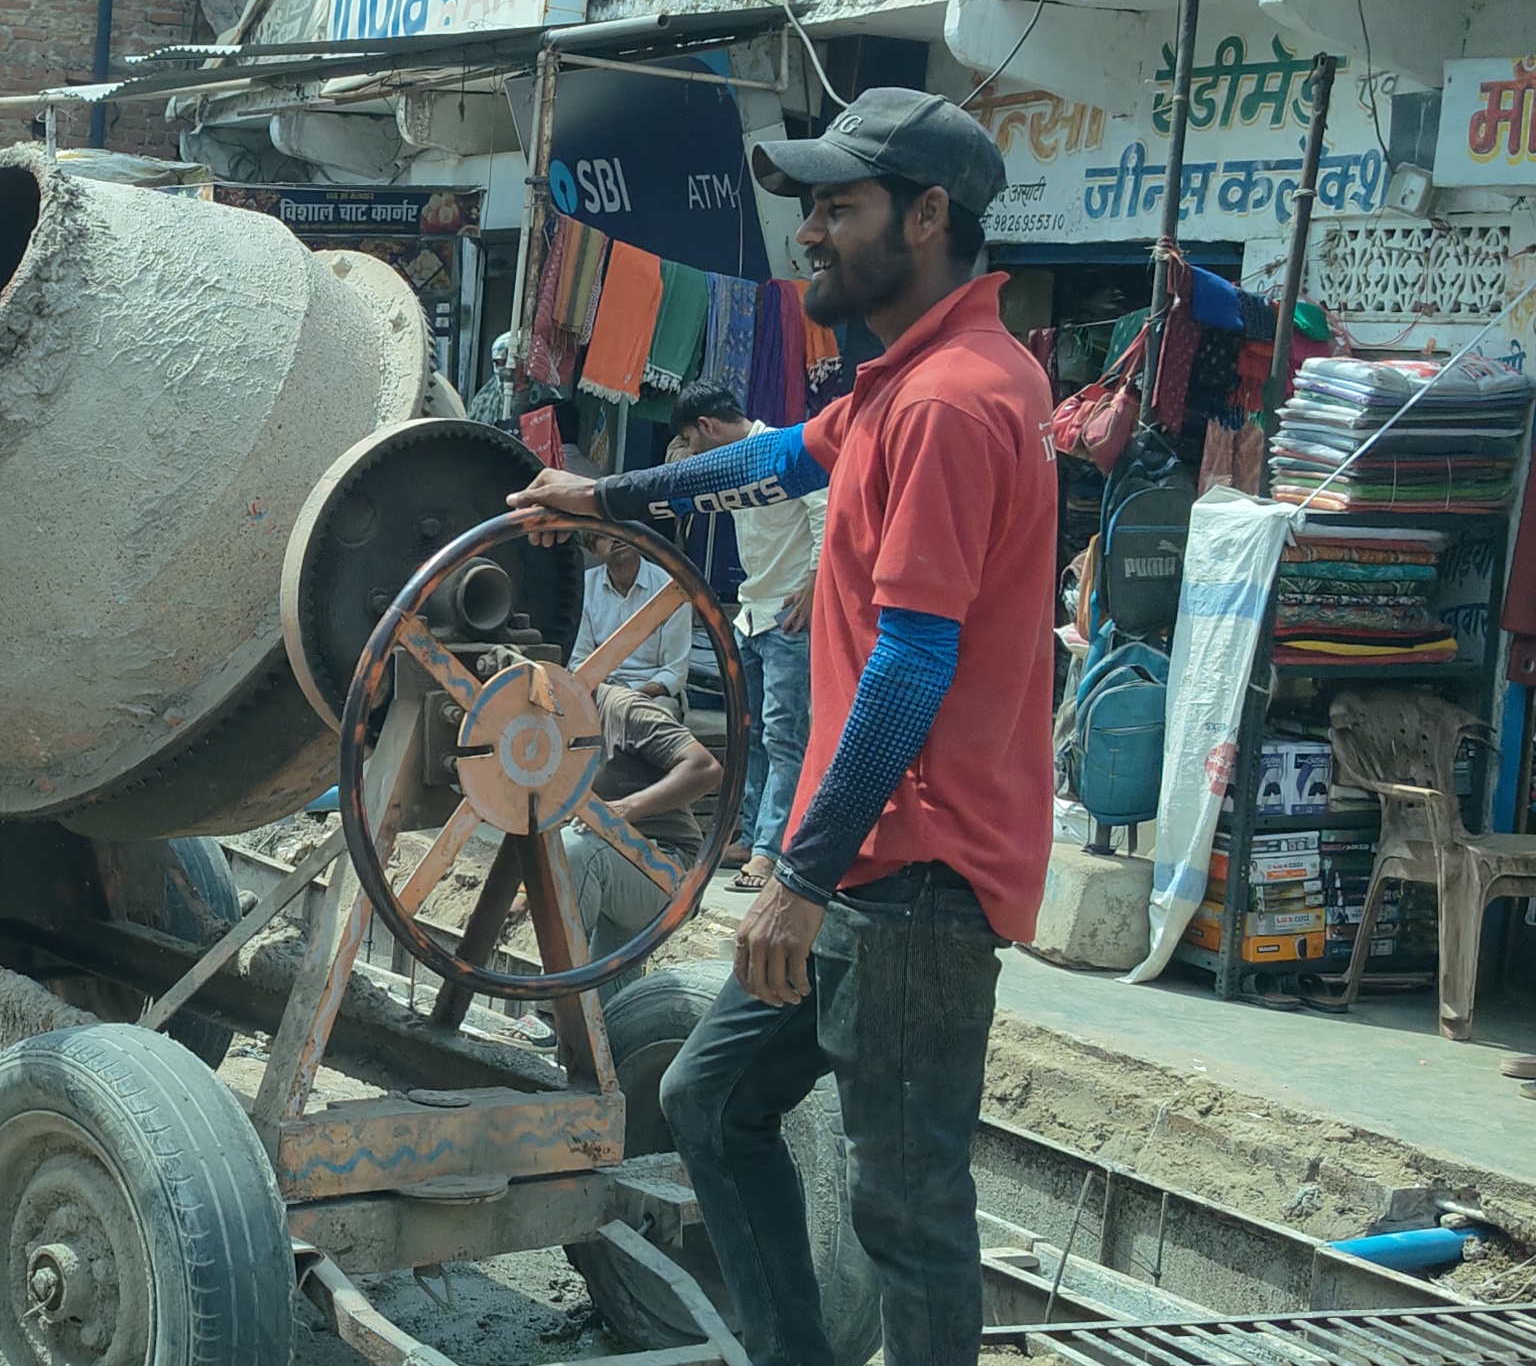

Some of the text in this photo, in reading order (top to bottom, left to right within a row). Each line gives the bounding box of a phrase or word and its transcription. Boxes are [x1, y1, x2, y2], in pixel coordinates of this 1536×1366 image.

[576, 157, 632, 214] SBI
[688, 173, 736, 210] ATM
[280, 198, 418, 222] विशाल चाट कार्नर
[1124, 557, 1176, 578] PUMA
